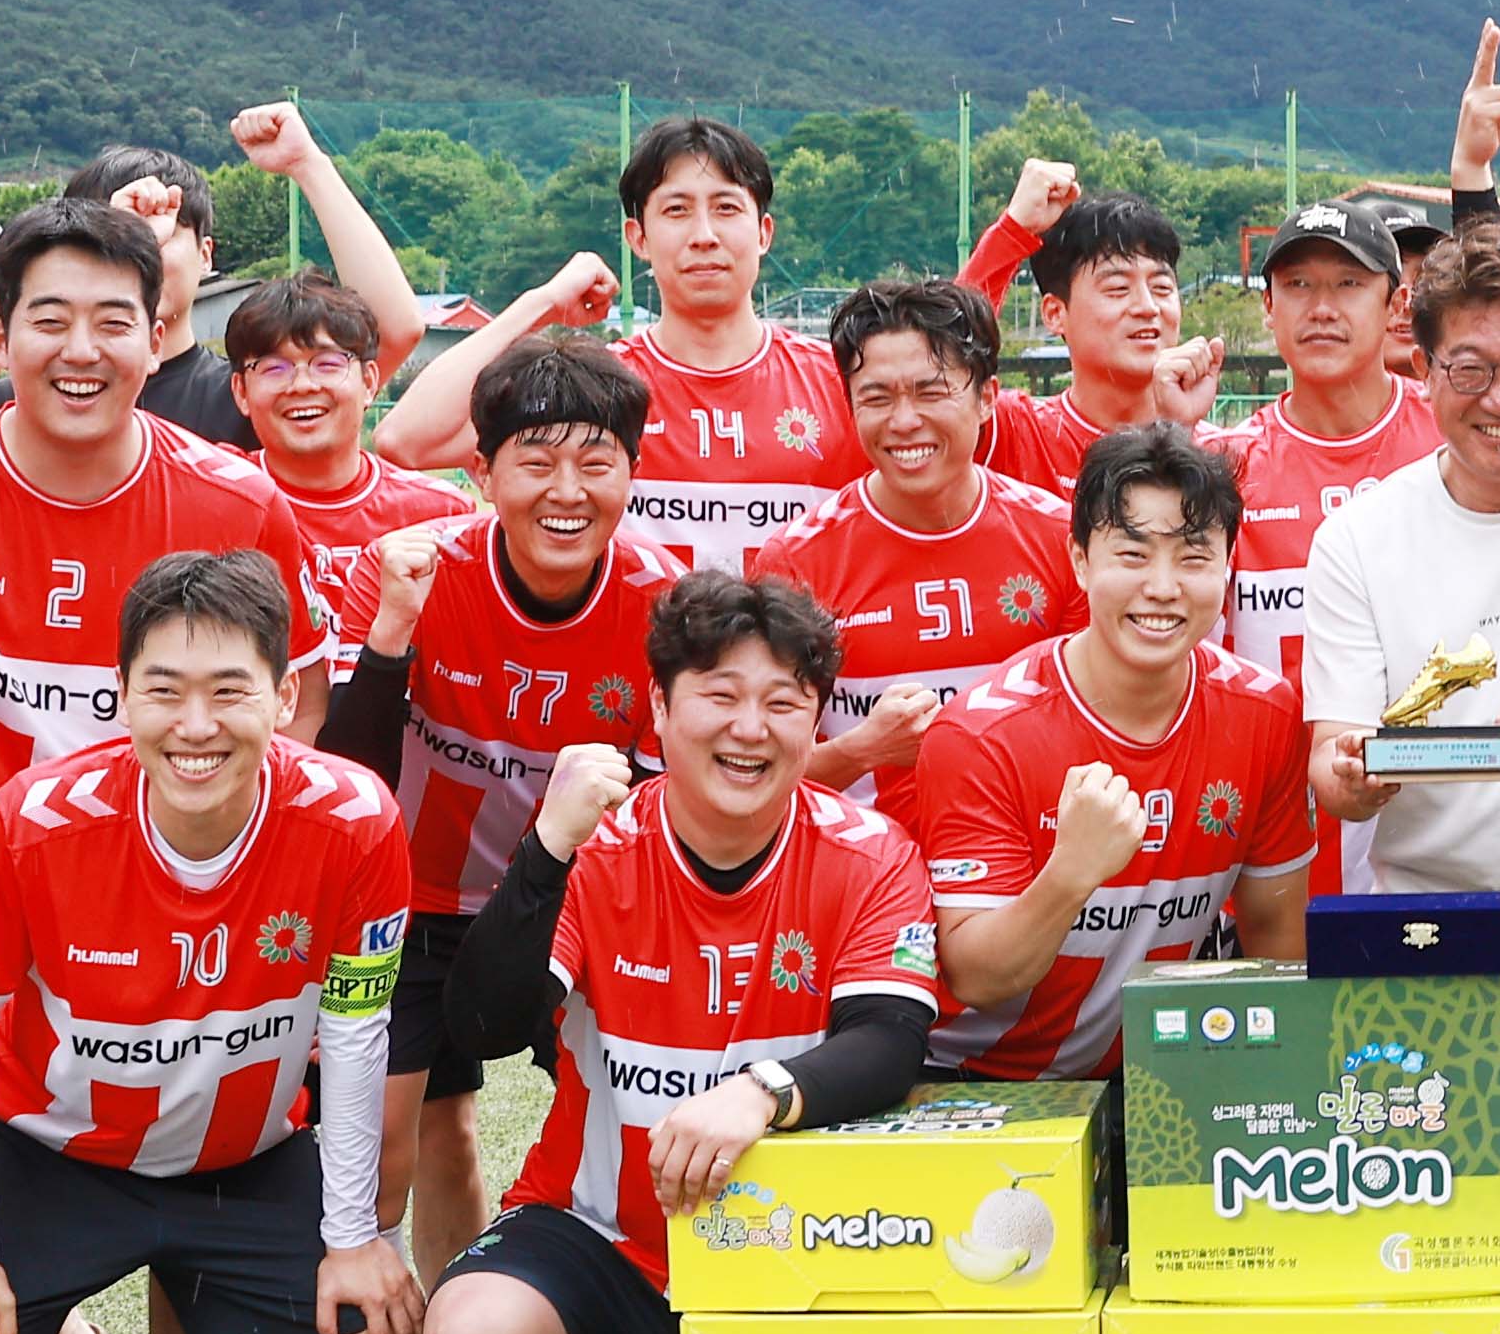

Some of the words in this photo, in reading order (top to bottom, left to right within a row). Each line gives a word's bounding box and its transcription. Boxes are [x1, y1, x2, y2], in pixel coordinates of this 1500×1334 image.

[690, 407, 746, 459] 14
[626, 495, 806, 527] wasun-gun
[1242, 504, 1300, 524] hummel
[45, 558, 87, 629] 2
[914, 577, 974, 642] 51
[433, 659, 483, 688] hummel
[502, 659, 569, 726] 77
[67, 943, 139, 967] hummel
[171, 922, 229, 989] 10
[1212, 1104, 1256, 1121] 싱그러운
[1260, 1103, 1294, 1118] 자연의
[1216, 1140, 1449, 1214] Melon
[803, 1208, 933, 1251] Melon
